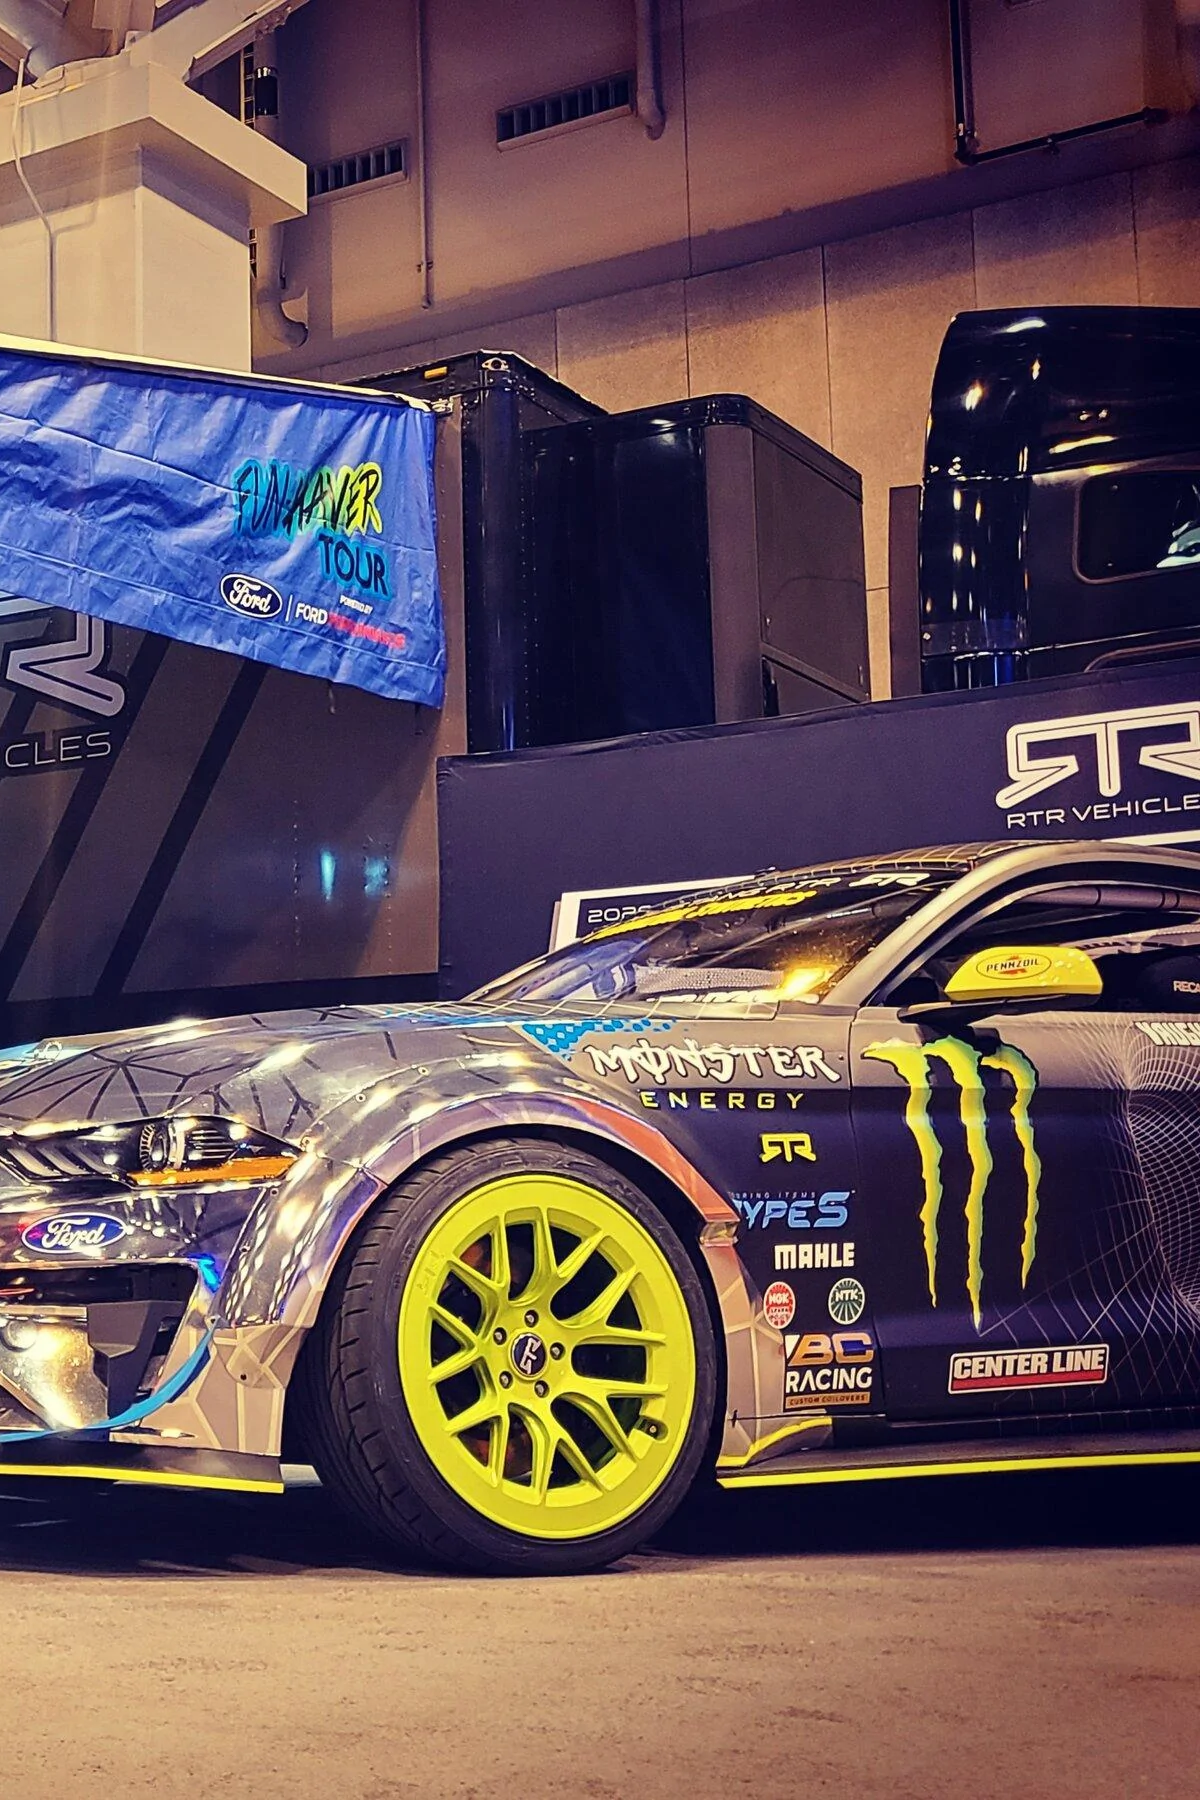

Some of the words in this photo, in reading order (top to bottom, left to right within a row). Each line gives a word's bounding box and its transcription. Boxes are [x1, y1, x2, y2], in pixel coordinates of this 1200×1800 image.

[315, 529, 390, 598] TOUR
[229, 578, 273, 613] Ford
[295, 602, 329, 625] FORD
[1007, 809, 1065, 829] RTR
[985, 957, 1041, 974] PENNZOIL
[583, 1038, 841, 1085] MONSTER
[640, 1091, 805, 1109] ENERGY
[761, 1133, 817, 1163] RTR
[41, 1217, 107, 1250] Ford
[774, 1242, 855, 1270] MAHLE
[768, 1292, 790, 1305] NGK
[835, 1289, 858, 1302] NTK
[953, 1352, 1048, 1380] CENTER
[1052, 1349, 1105, 1373] LINE
[785, 1367, 872, 1393] RACING
[789, 1396, 820, 1406] CUSTOM
[821, 1394, 866, 1404] COILOVERS
